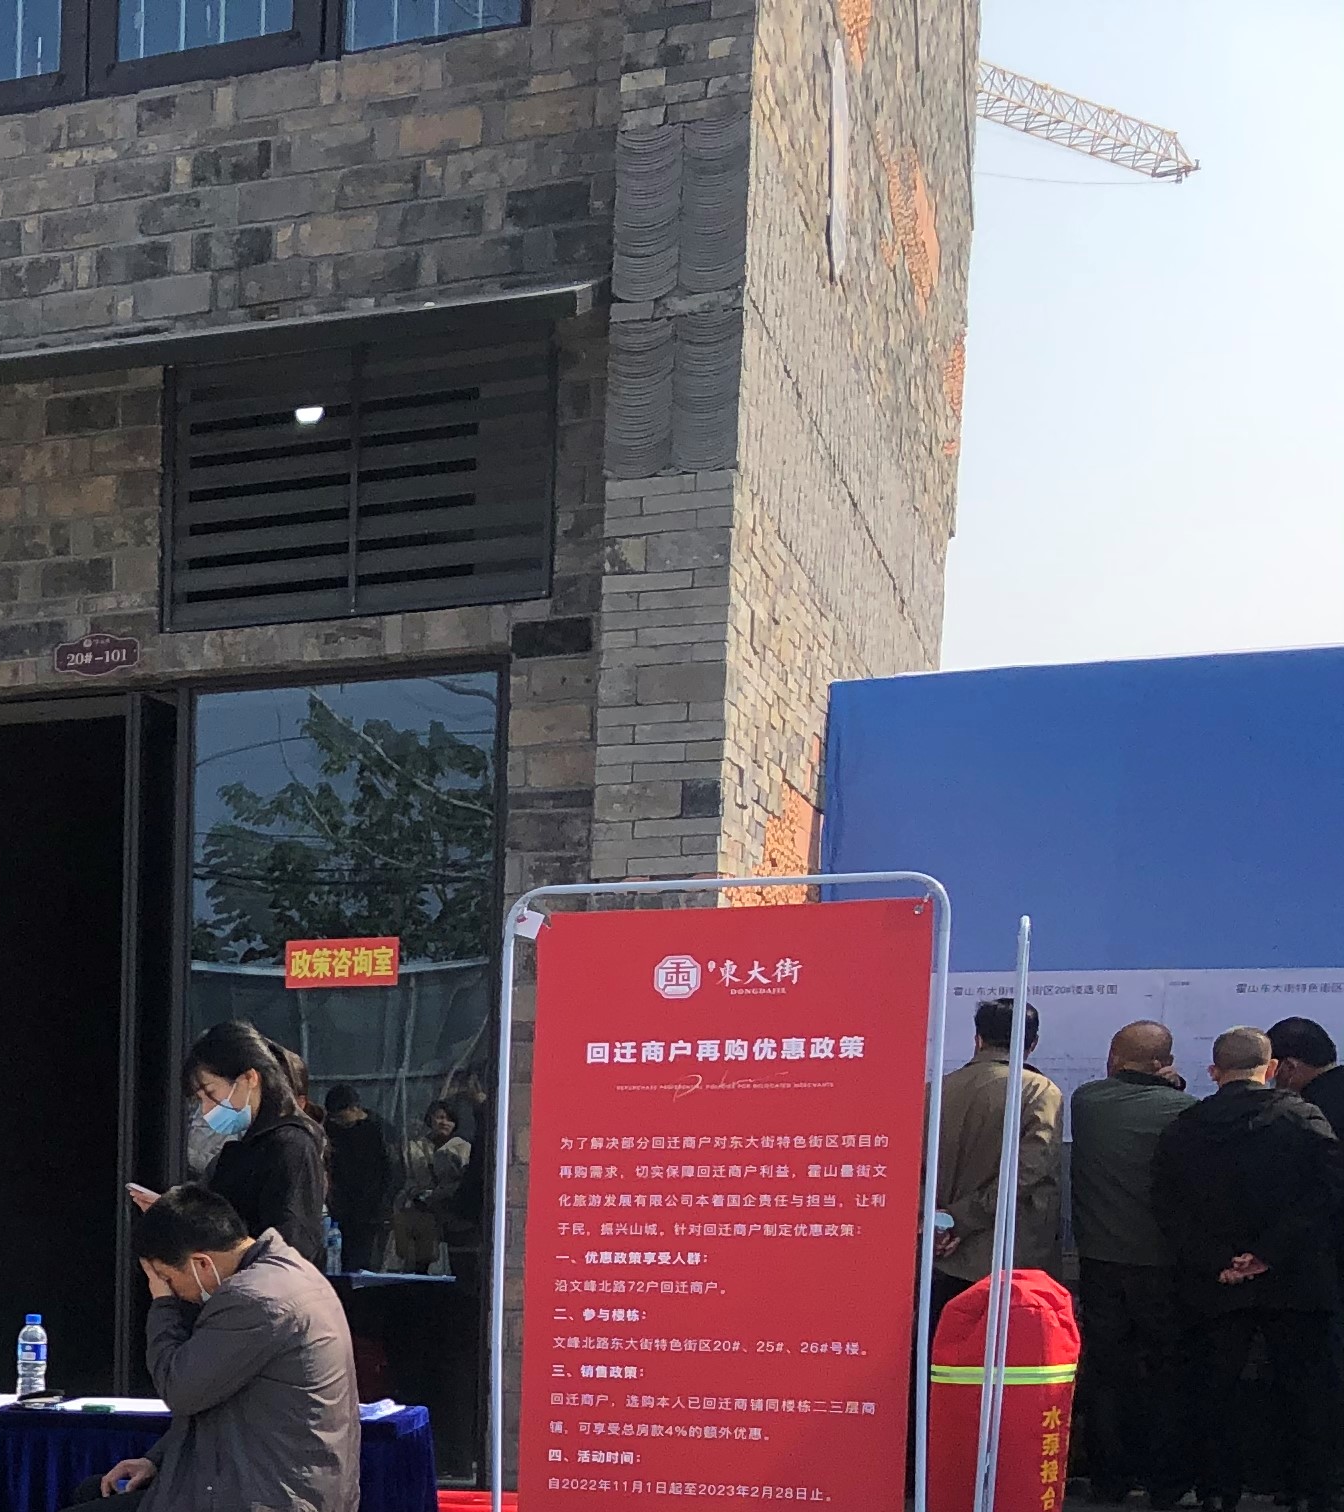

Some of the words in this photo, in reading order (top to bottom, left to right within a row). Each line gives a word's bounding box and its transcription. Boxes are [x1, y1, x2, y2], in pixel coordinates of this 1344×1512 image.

[291, 947, 394, 979] 政策咨询室
[716, 958, 803, 987] 東大街
[586, 1036, 864, 1064] 回迁商户再购优惠政策
[560, 1135, 889, 1150] 为了解决部分回迁商户对东大街特色街区项目的
[556, 1251, 709, 1265] 一、优惠政策享受人群：
